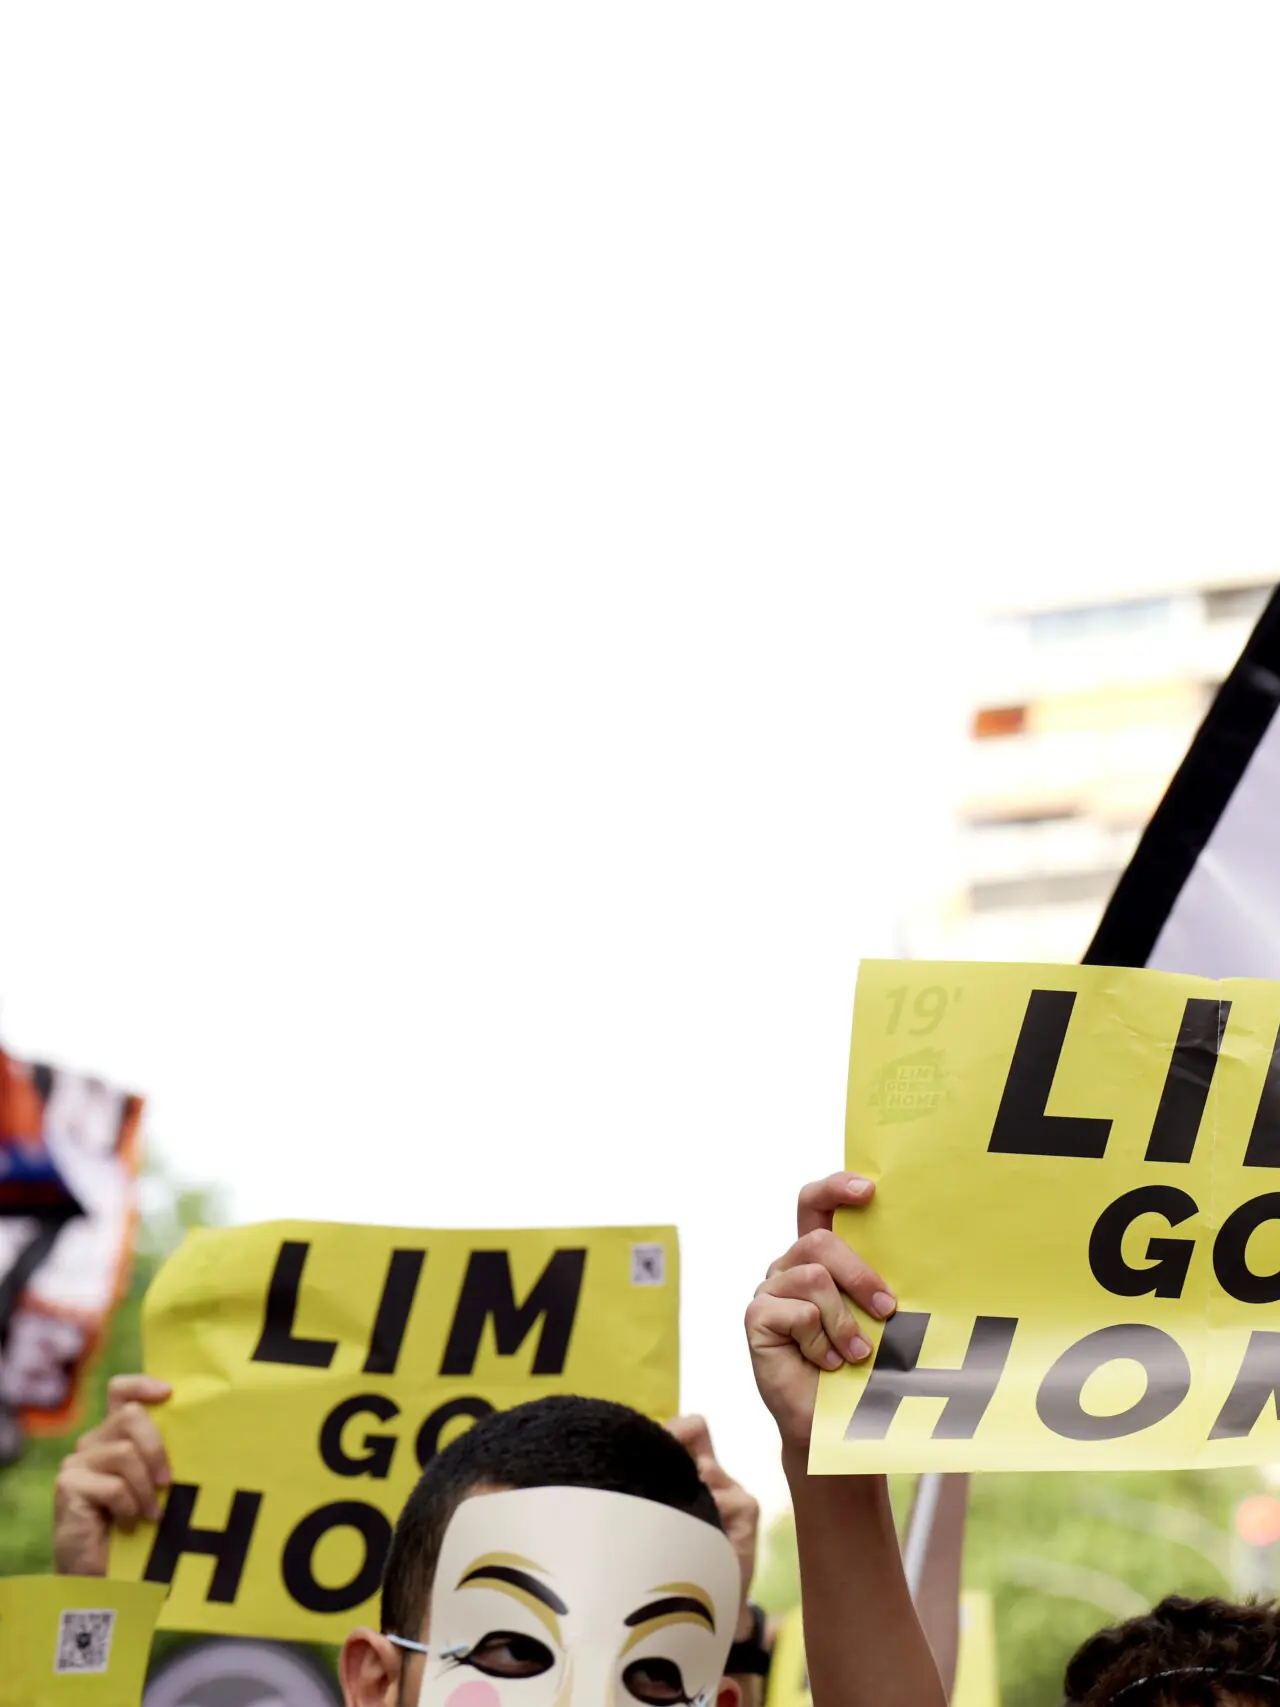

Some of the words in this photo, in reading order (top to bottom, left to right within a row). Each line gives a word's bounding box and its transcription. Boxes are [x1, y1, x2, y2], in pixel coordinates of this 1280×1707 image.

[888, 1093, 942, 1108] HOME
[898, 1066, 930, 1080] LIM
[250, 1241, 588, 1376] LIM
[142, 1483, 393, 1613] HO
